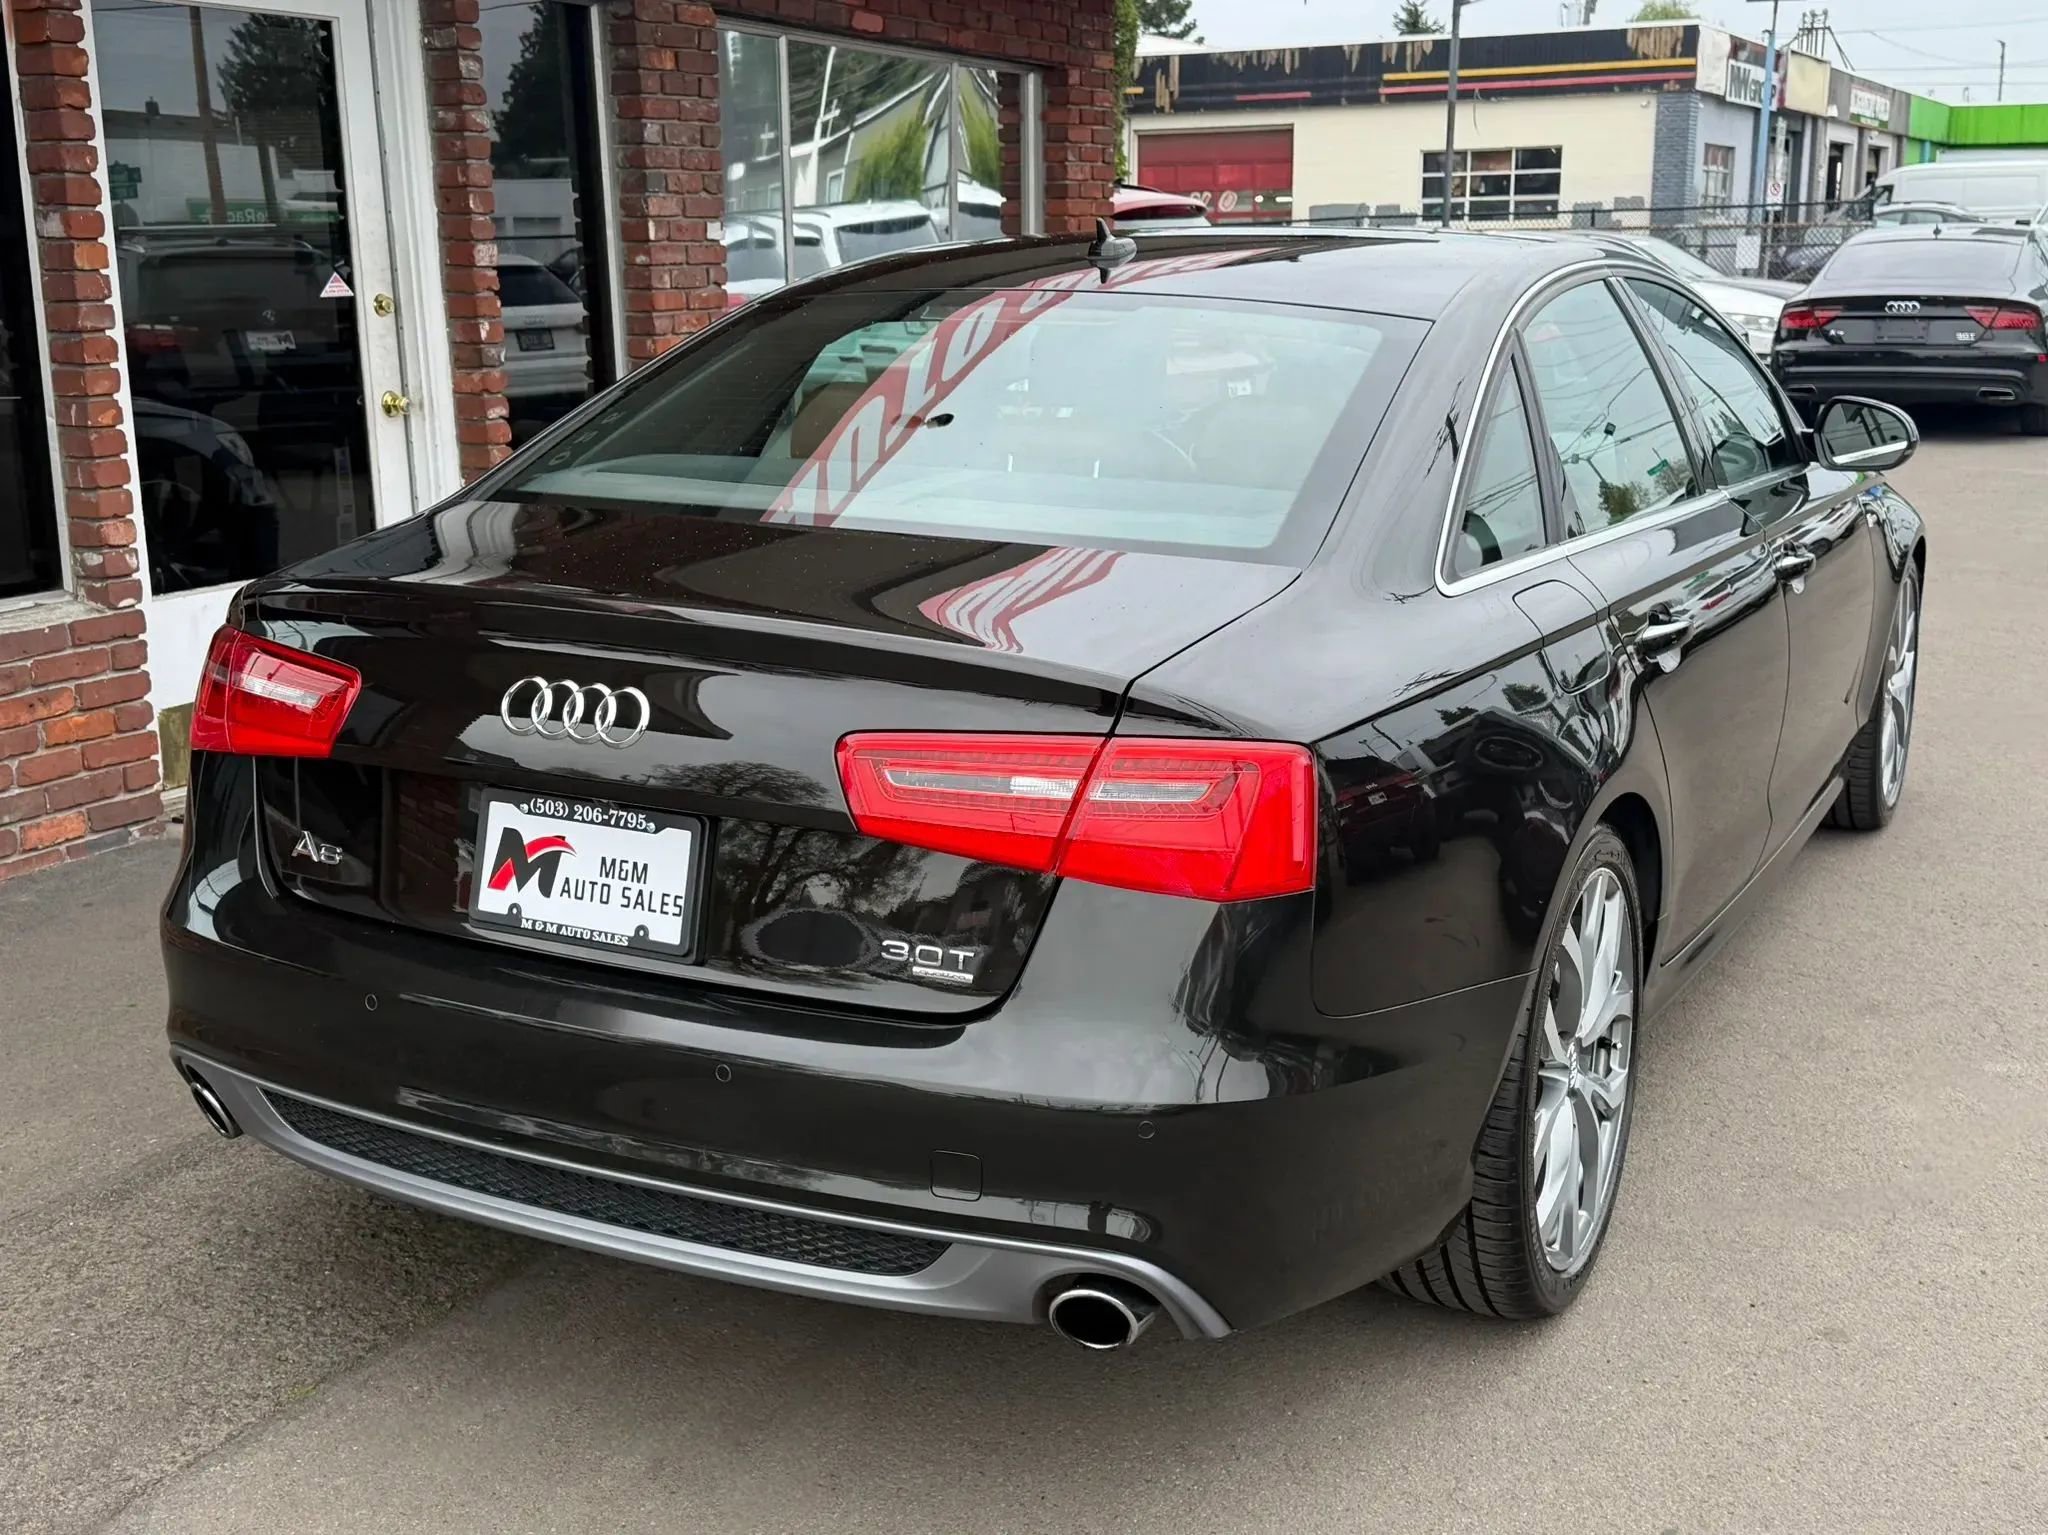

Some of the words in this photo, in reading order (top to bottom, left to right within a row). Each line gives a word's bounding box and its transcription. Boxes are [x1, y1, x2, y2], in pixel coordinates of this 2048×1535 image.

[1749, 78, 1777, 106] GRP
[530, 797, 569, 819] (503)
[573, 804, 647, 831] 206-7795
[291, 830, 344, 865] A6
[599, 856, 649, 885] M&M
[560, 877, 611, 905] AUTO
[621, 886, 684, 918] SALES
[520, 917, 533, 930] M
[546, 923, 558, 934] M
[560, 924, 590, 940] AUTO
[592, 930, 629, 947] SALES
